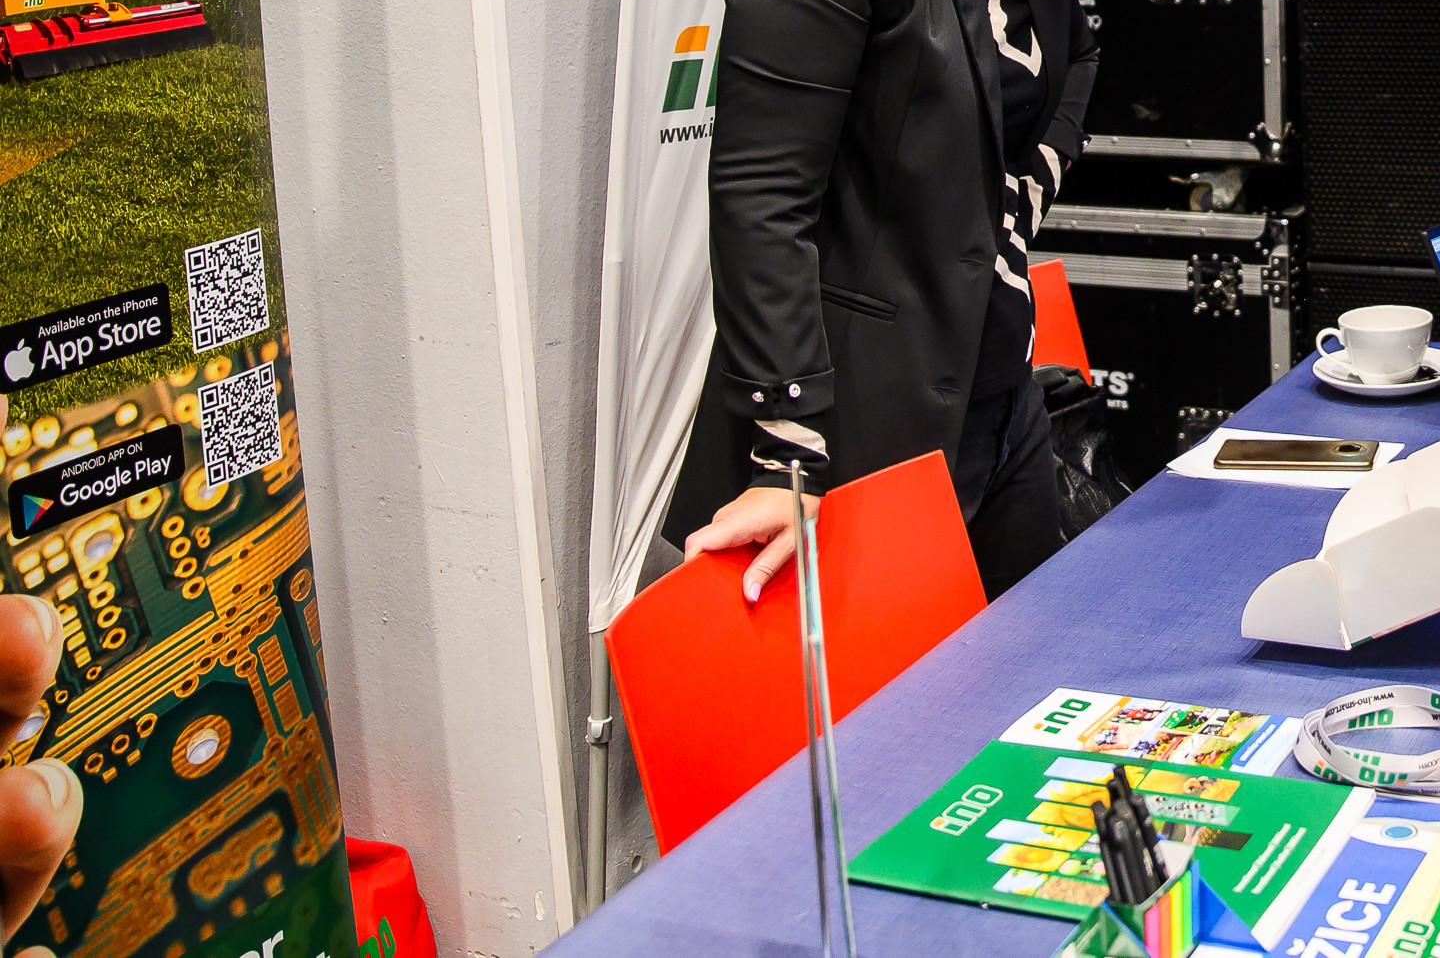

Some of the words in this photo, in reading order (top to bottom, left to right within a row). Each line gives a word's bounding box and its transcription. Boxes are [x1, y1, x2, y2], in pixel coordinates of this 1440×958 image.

[38, 315, 86, 338] Available
[87, 310, 101, 324] on
[103, 304, 121, 319] the
[122, 294, 158, 315] iPhone
[41, 336, 94, 370] App
[98, 315, 162, 350] Store
[60, 469, 132, 506] Google
[135, 454, 172, 483] Play
[61, 456, 106, 480] ANDROID
[108, 448, 125, 462] APP
[127, 442, 143, 455] ON
[1034, 698, 1091, 734] ino
[1358, 766, 1408, 785] ino
[930, 784, 1003, 836] ino
